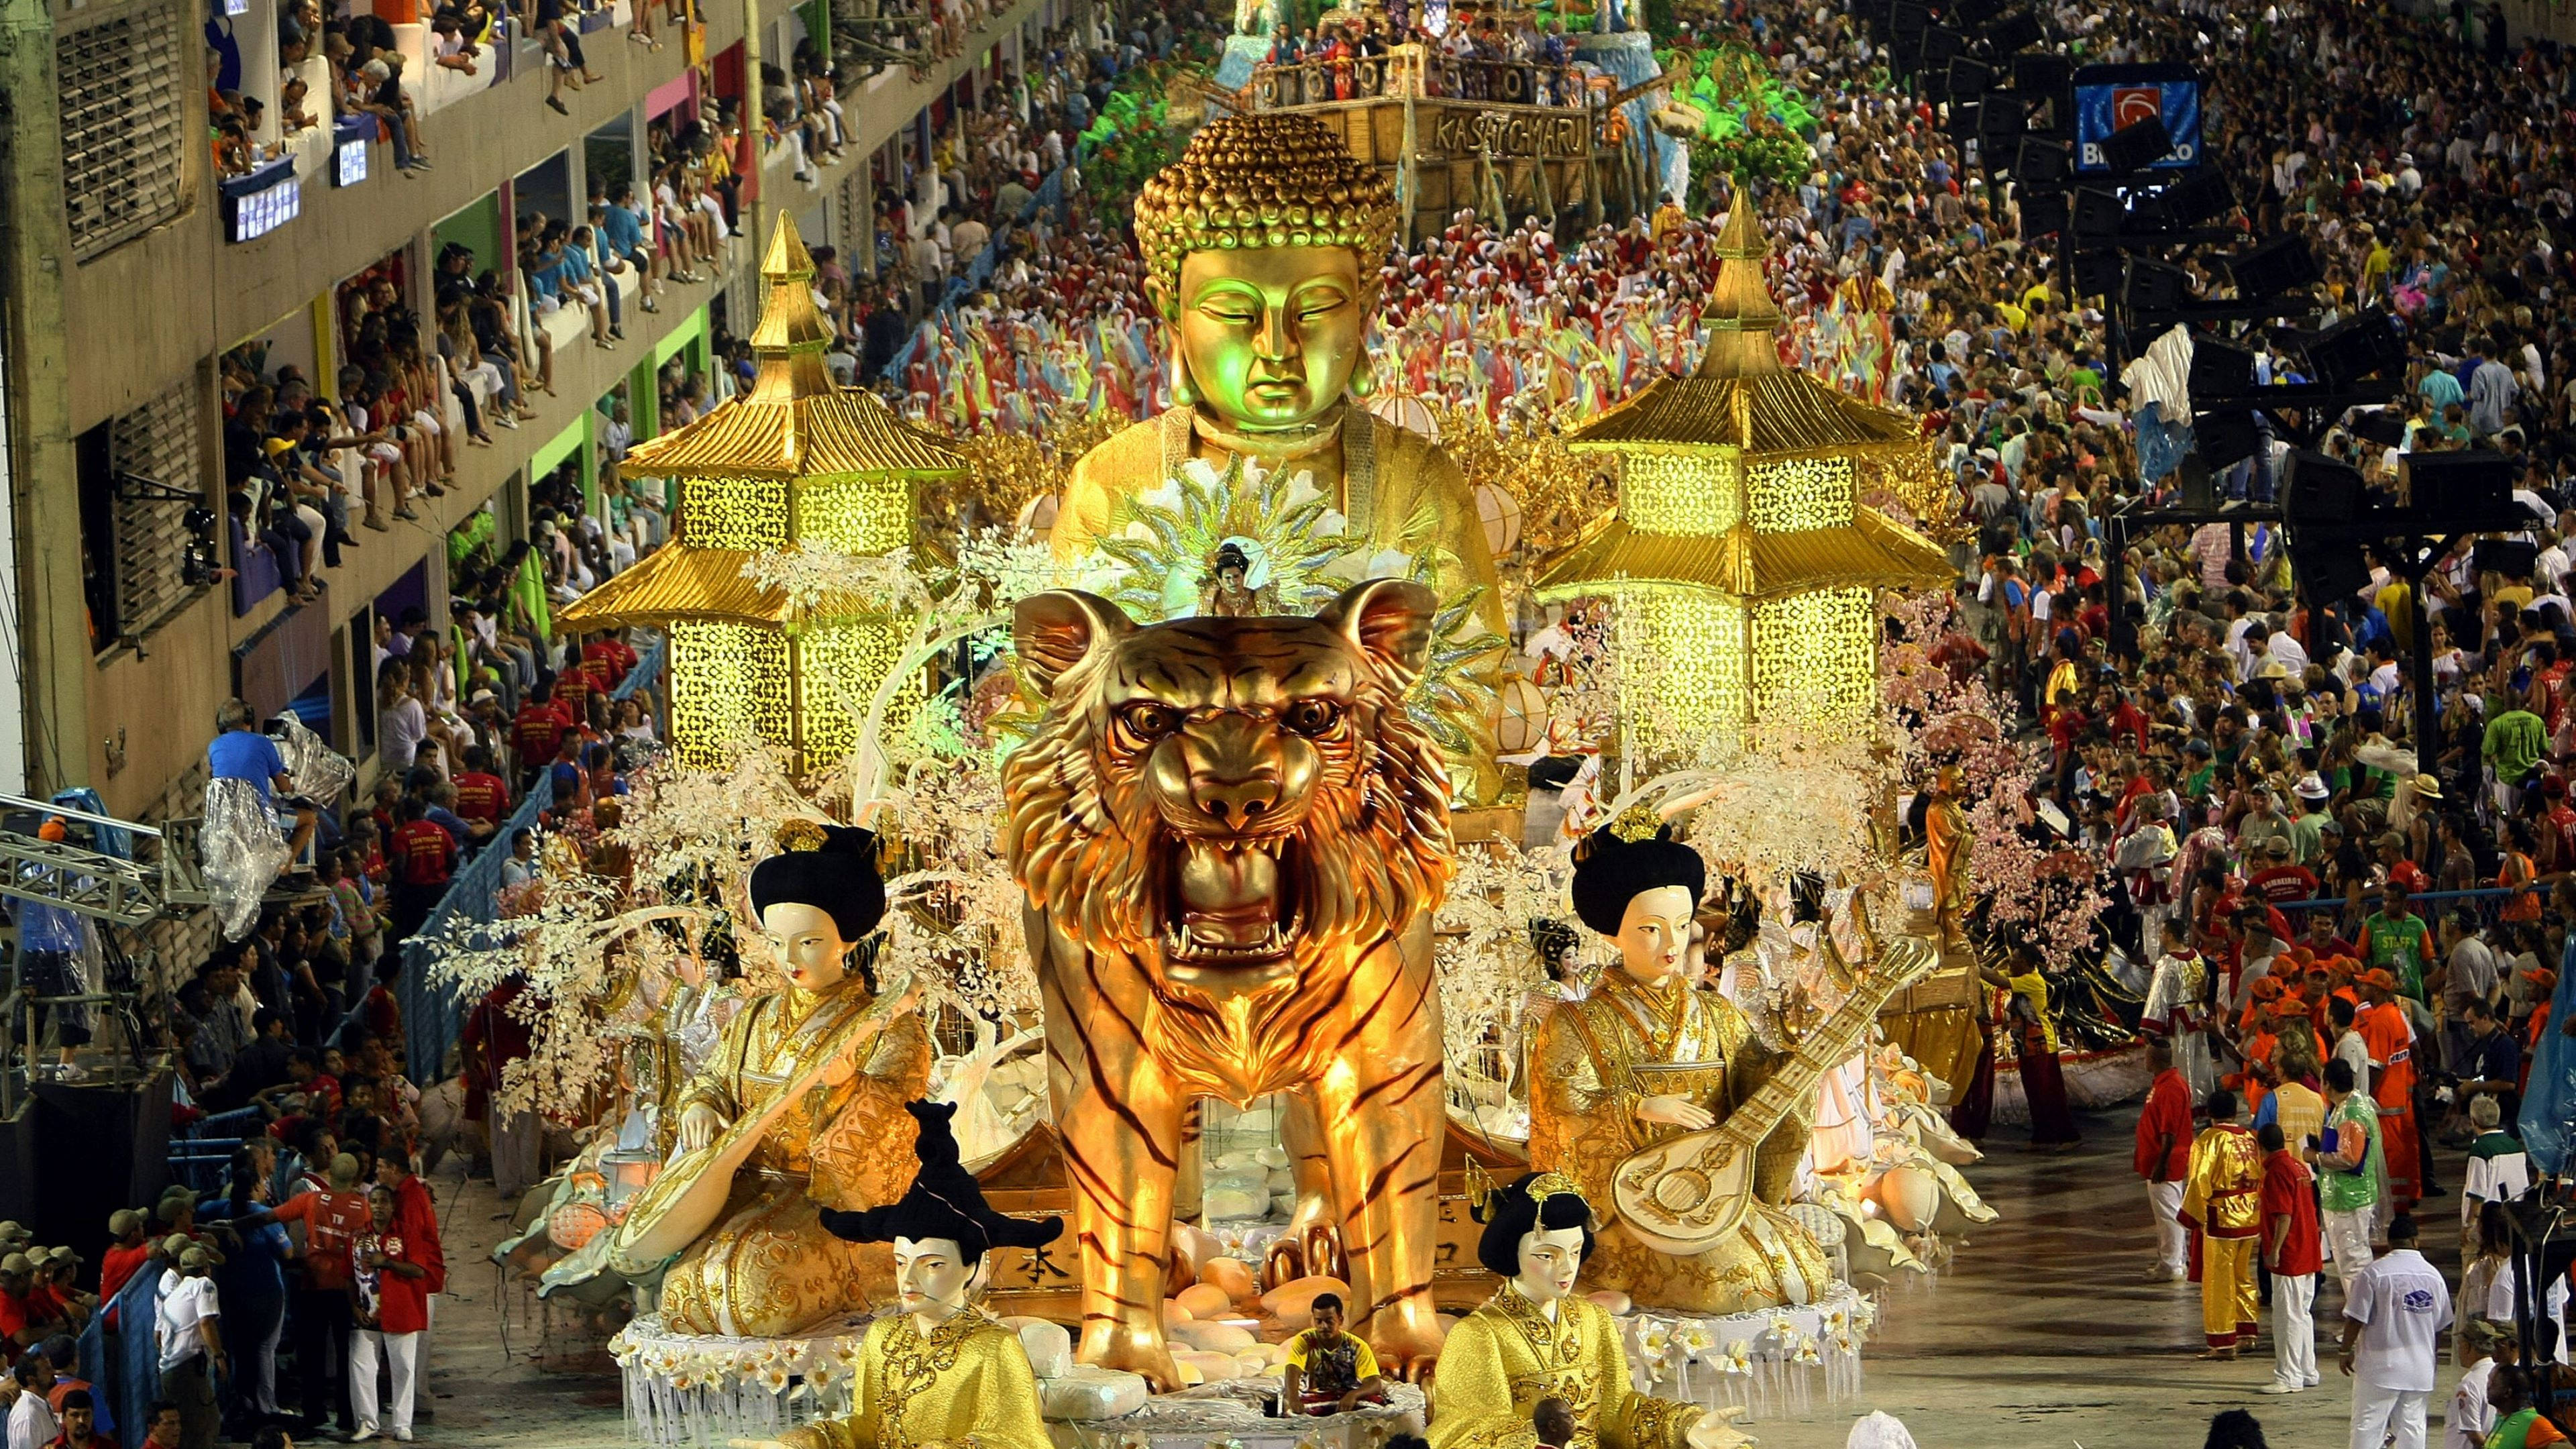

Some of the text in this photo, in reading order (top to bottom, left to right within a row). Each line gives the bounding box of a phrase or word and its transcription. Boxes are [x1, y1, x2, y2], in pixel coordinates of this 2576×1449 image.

[2522, 519, 2540, 530] 25
[2261, 877, 2302, 891] BOMBEIROS
[2382, 935, 2410, 949] STAFF
